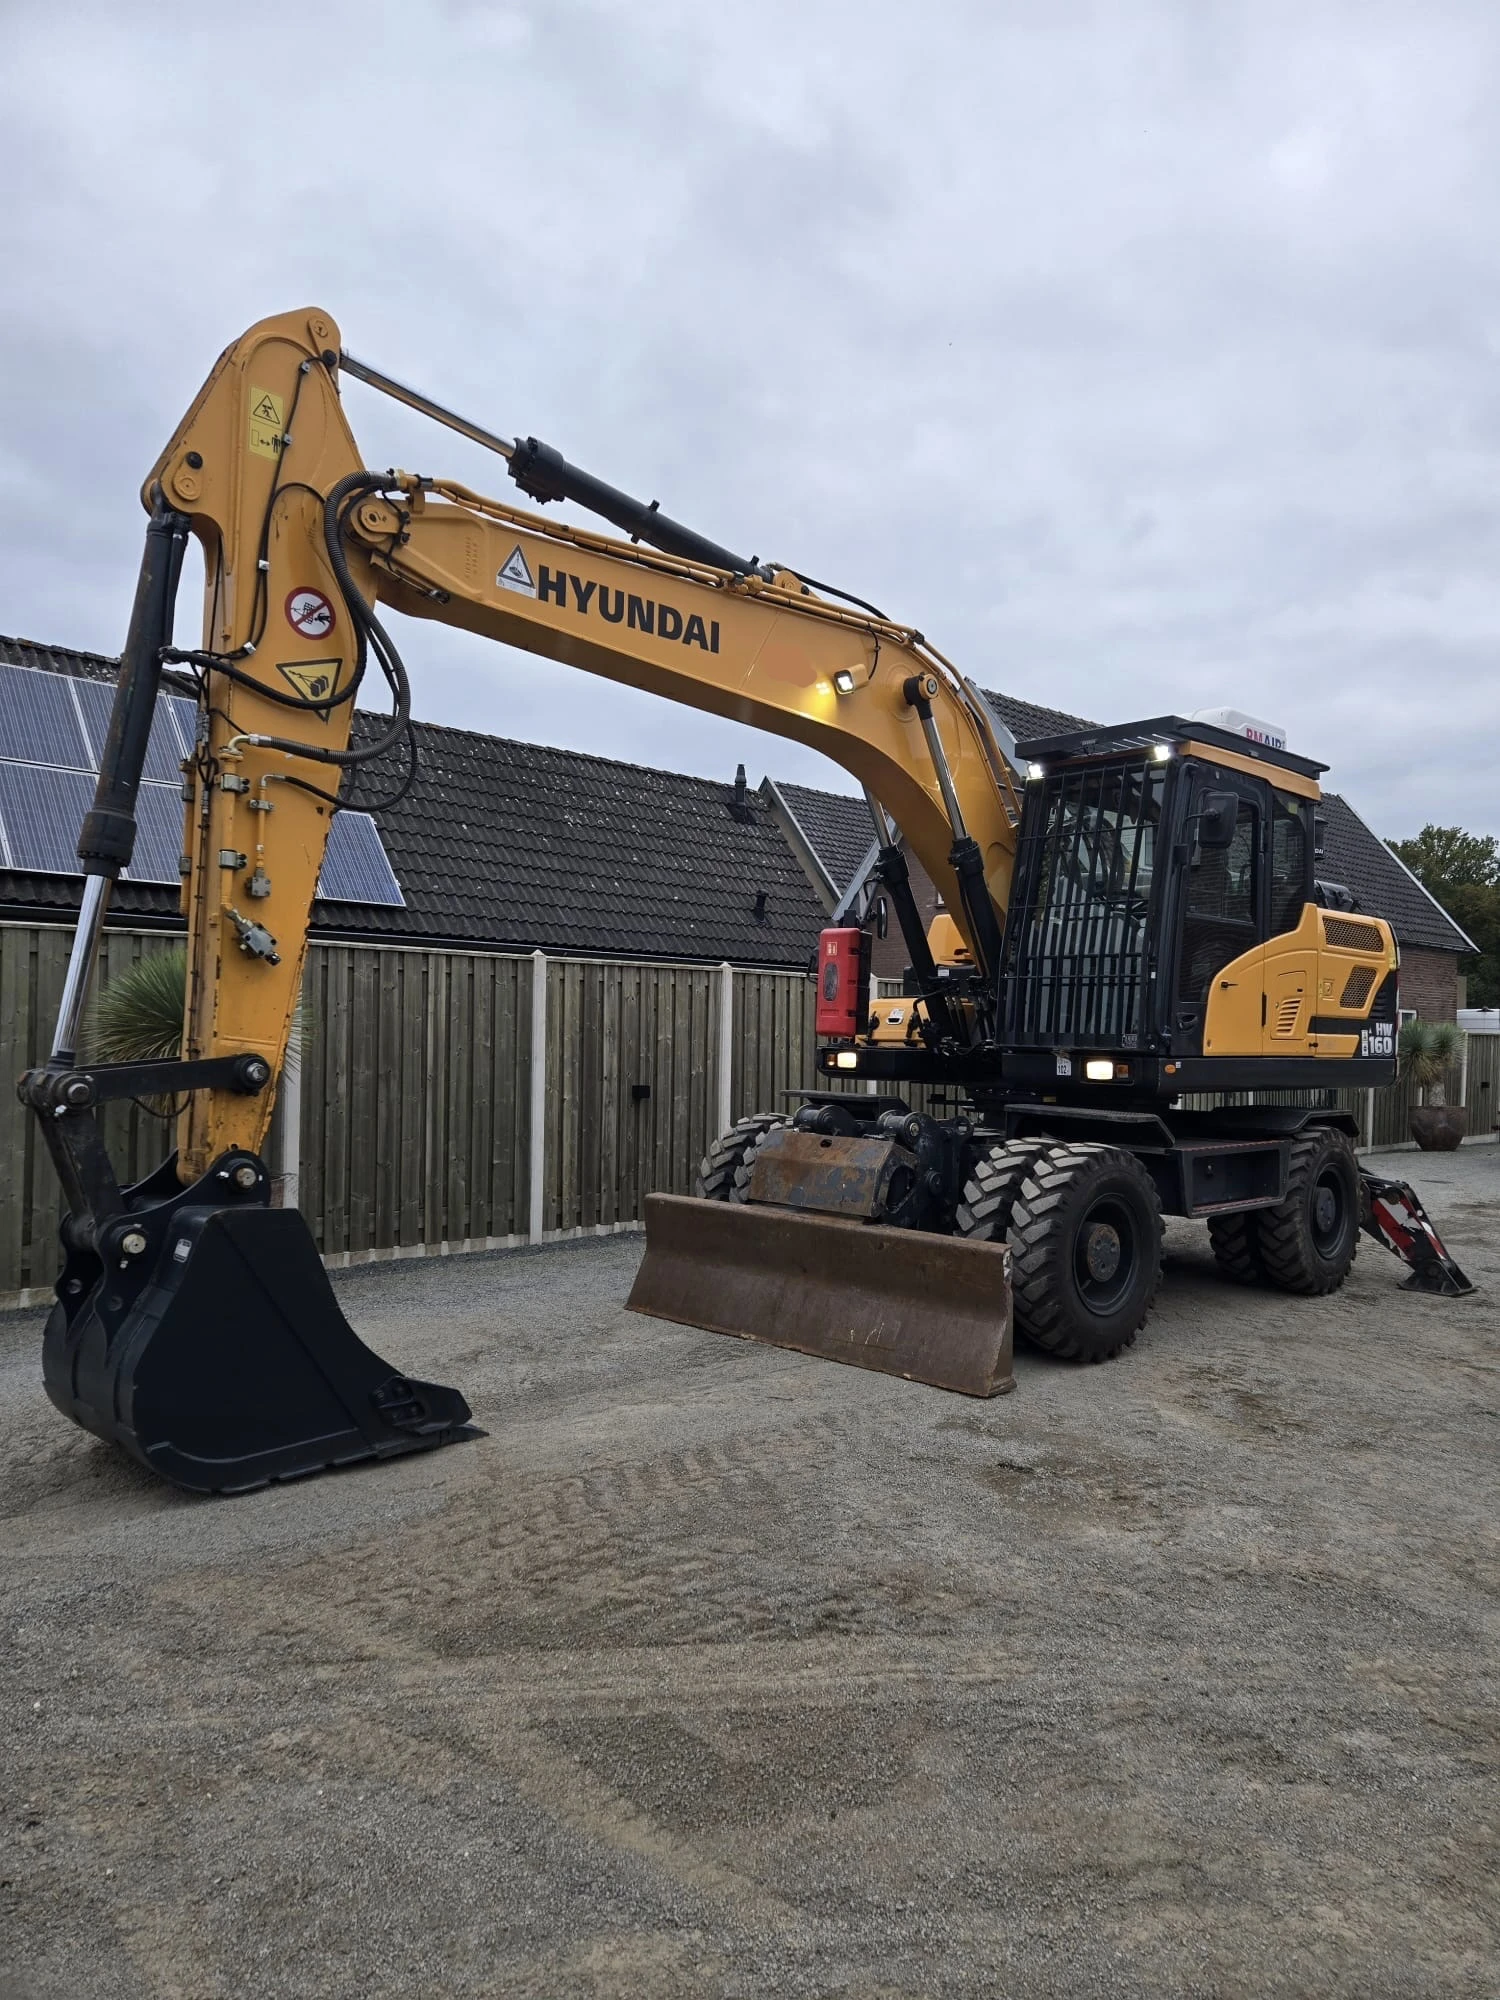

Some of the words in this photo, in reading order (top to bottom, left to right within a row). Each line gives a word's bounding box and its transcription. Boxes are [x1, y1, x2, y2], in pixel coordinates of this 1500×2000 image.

[538, 564, 720, 654] HYUNDAI
[1375, 1022, 1393, 1036] HW
[1369, 1036, 1393, 1055] 160
